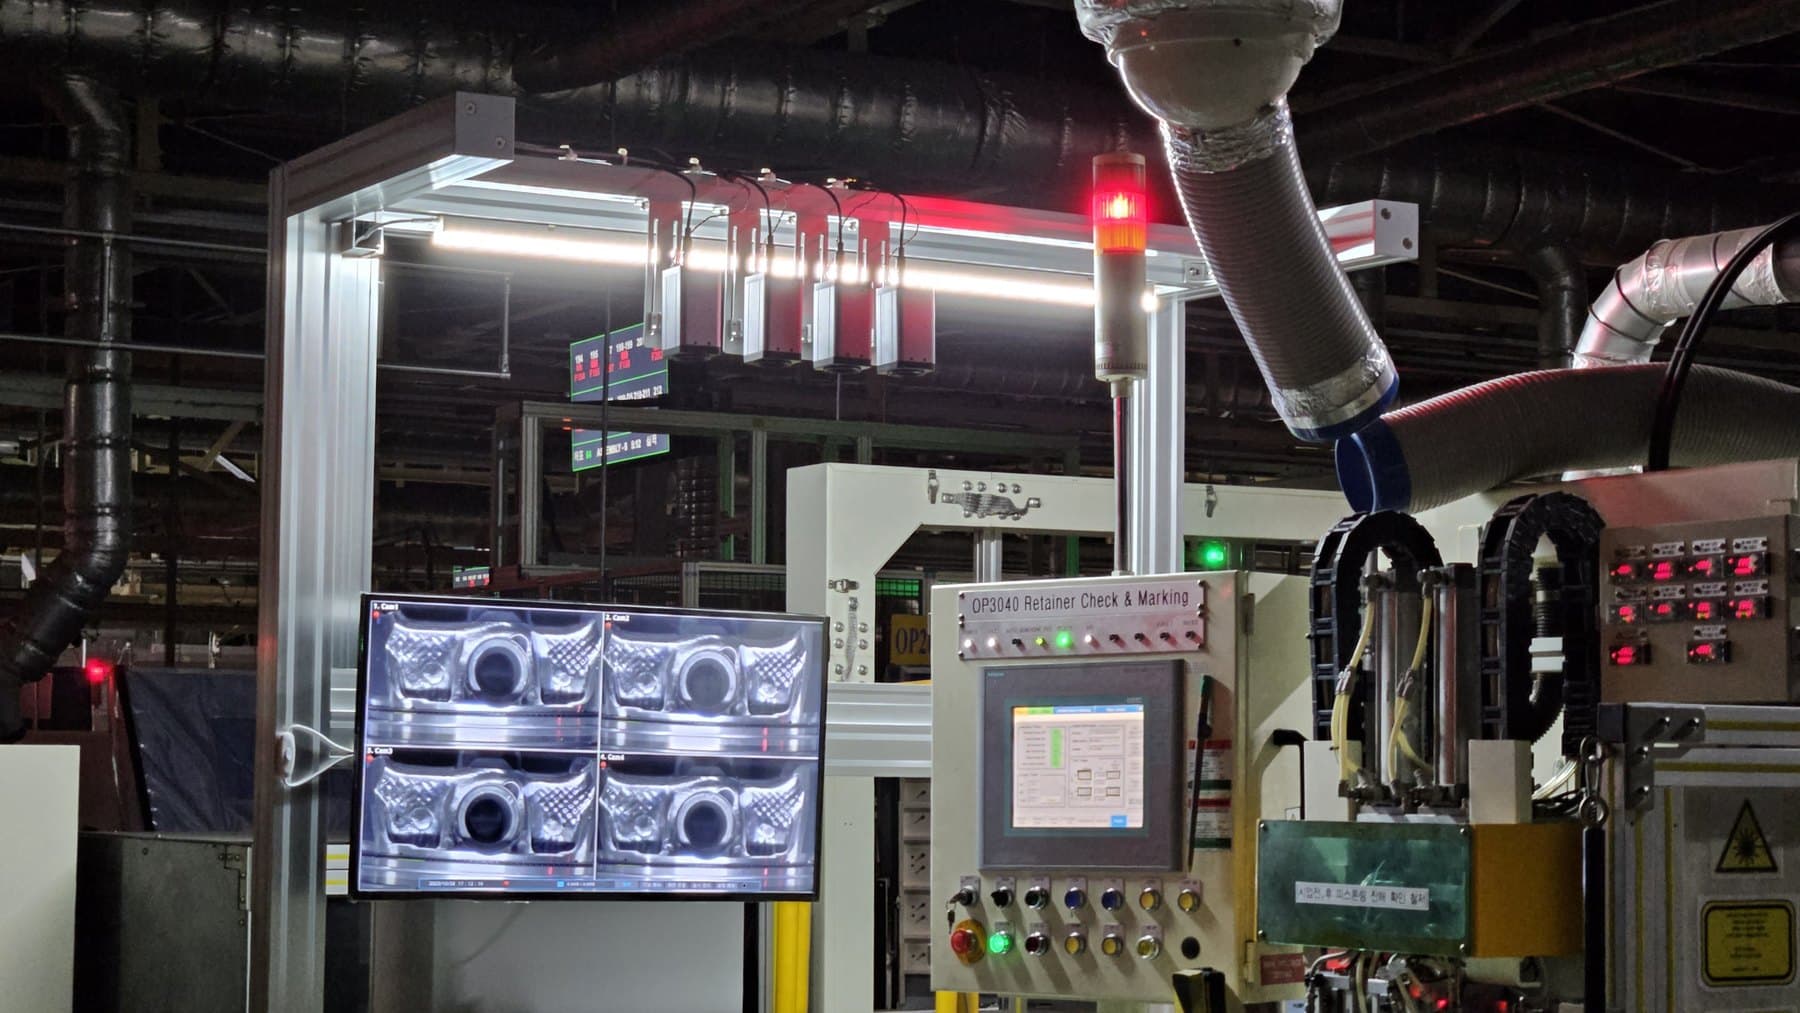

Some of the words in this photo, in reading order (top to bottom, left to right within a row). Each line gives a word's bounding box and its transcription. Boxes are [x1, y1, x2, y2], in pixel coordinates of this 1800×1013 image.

[972, 596, 1019, 614] OP3040
[1024, 594, 1075, 611] Retainer
[1081, 592, 1118, 608] Check
[1124, 591, 1132, 607] &
[1138, 588, 1189, 607] Marking
